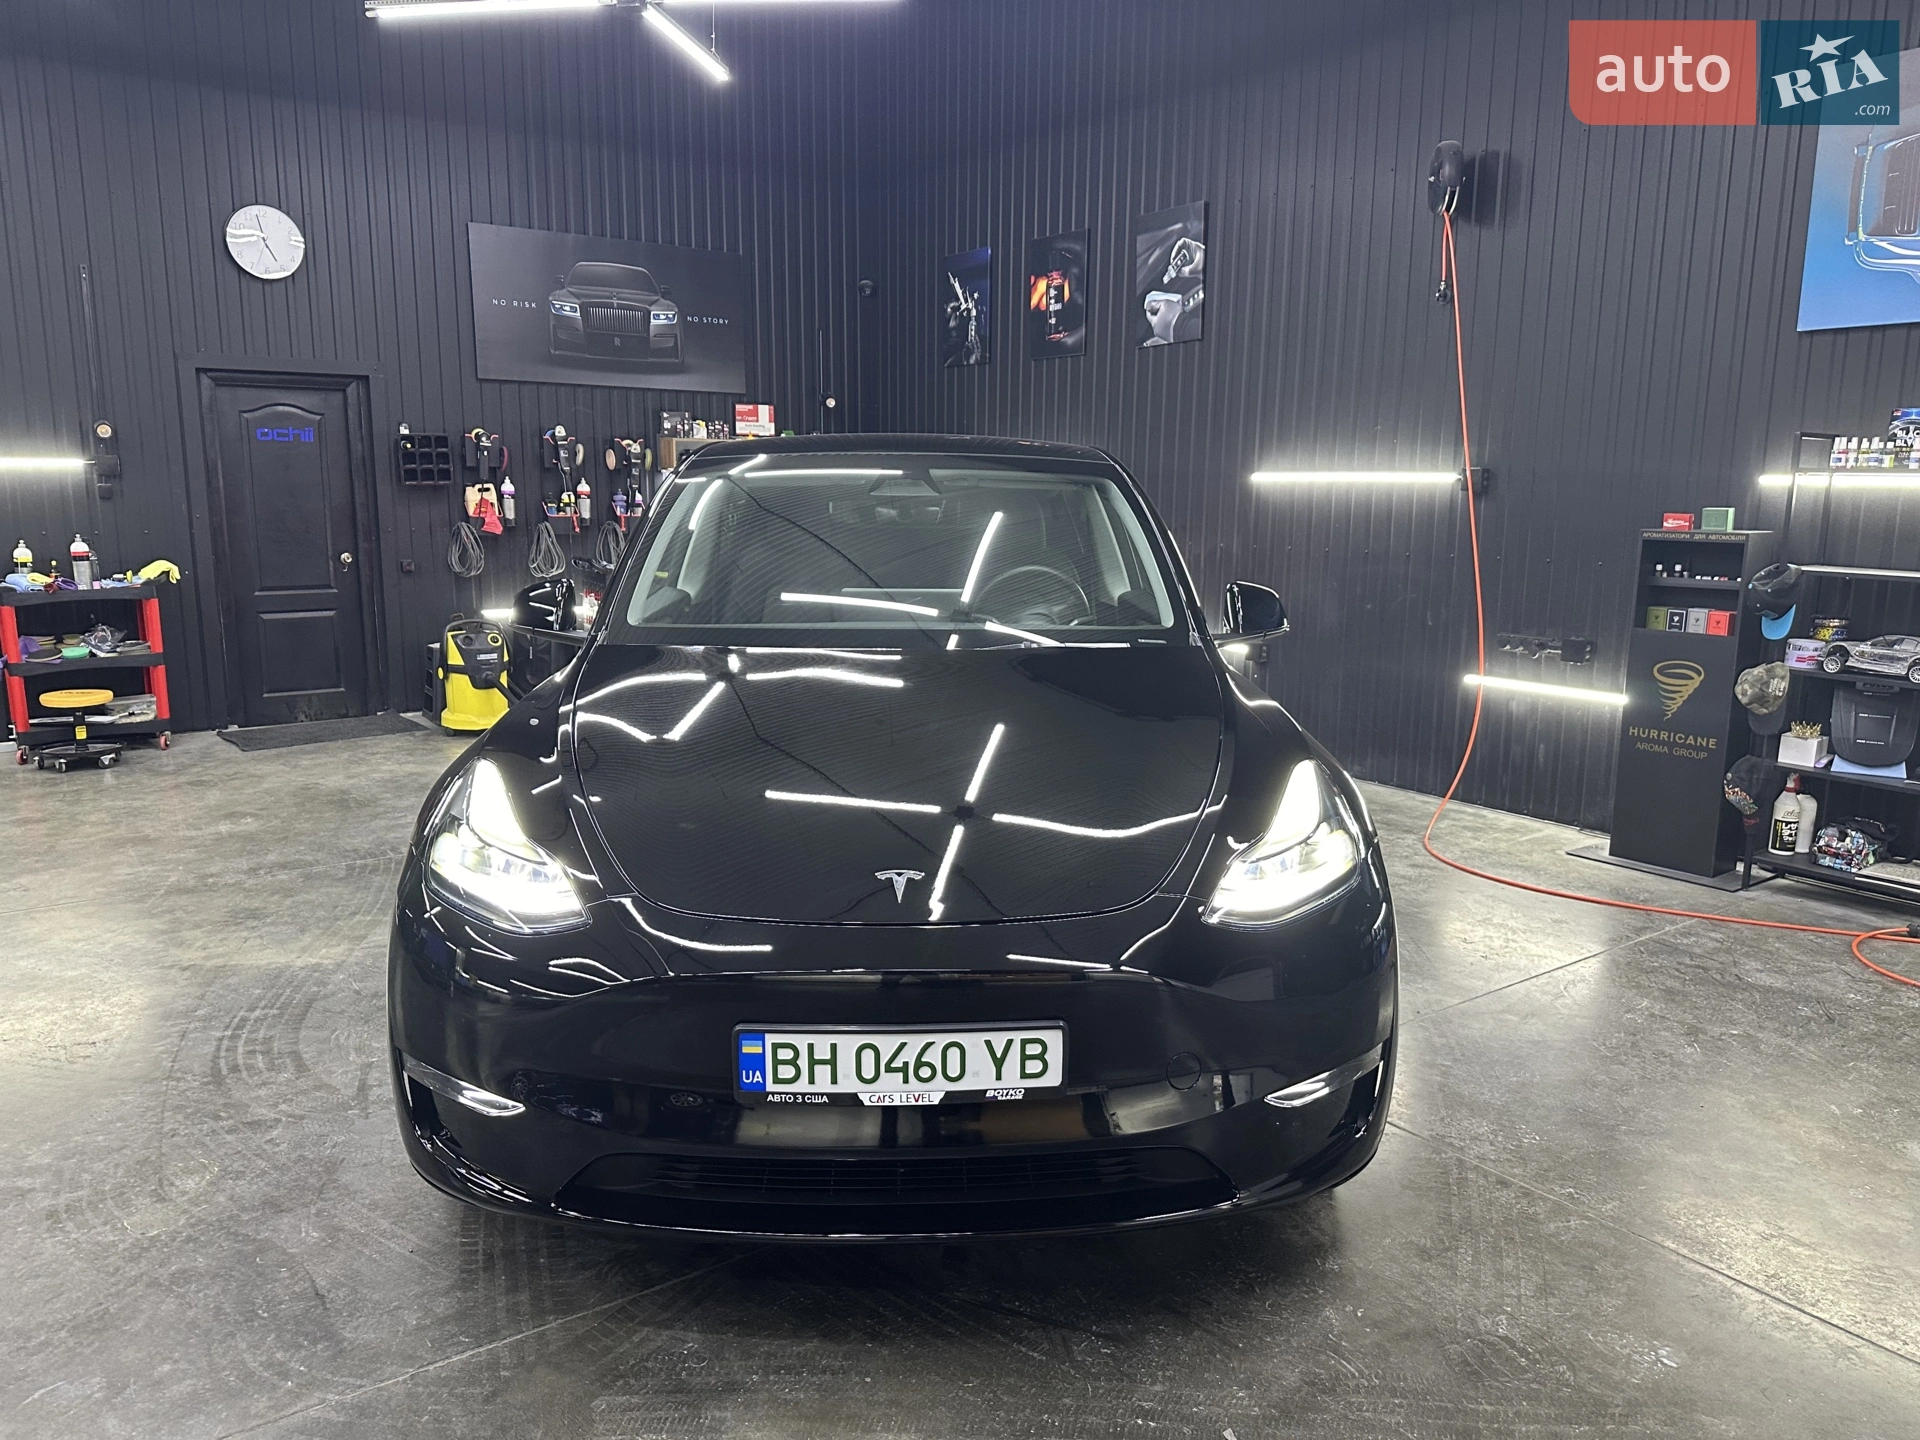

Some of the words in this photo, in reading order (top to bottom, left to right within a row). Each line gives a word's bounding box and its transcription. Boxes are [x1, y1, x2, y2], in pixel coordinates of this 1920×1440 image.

[513, 300, 537, 308] RISK
[703, 317, 729, 325] STORY
[256, 426, 314, 442] ochii
[1629, 726, 1718, 749] HURRICANE
[1635, 741, 1669, 754] AROMA
[1672, 747, 1708, 760] GROUP
[771, 1042, 838, 1085] BH
[855, 1041, 966, 1085] 0460
[983, 1037, 1049, 1081] YB
[742, 1070, 764, 1083] UA
[899, 1093, 935, 1103] LEVEL
[986, 1088, 1025, 1097] BOYKO
[766, 1094, 794, 1103] АВТО
[805, 1095, 829, 1103] США
